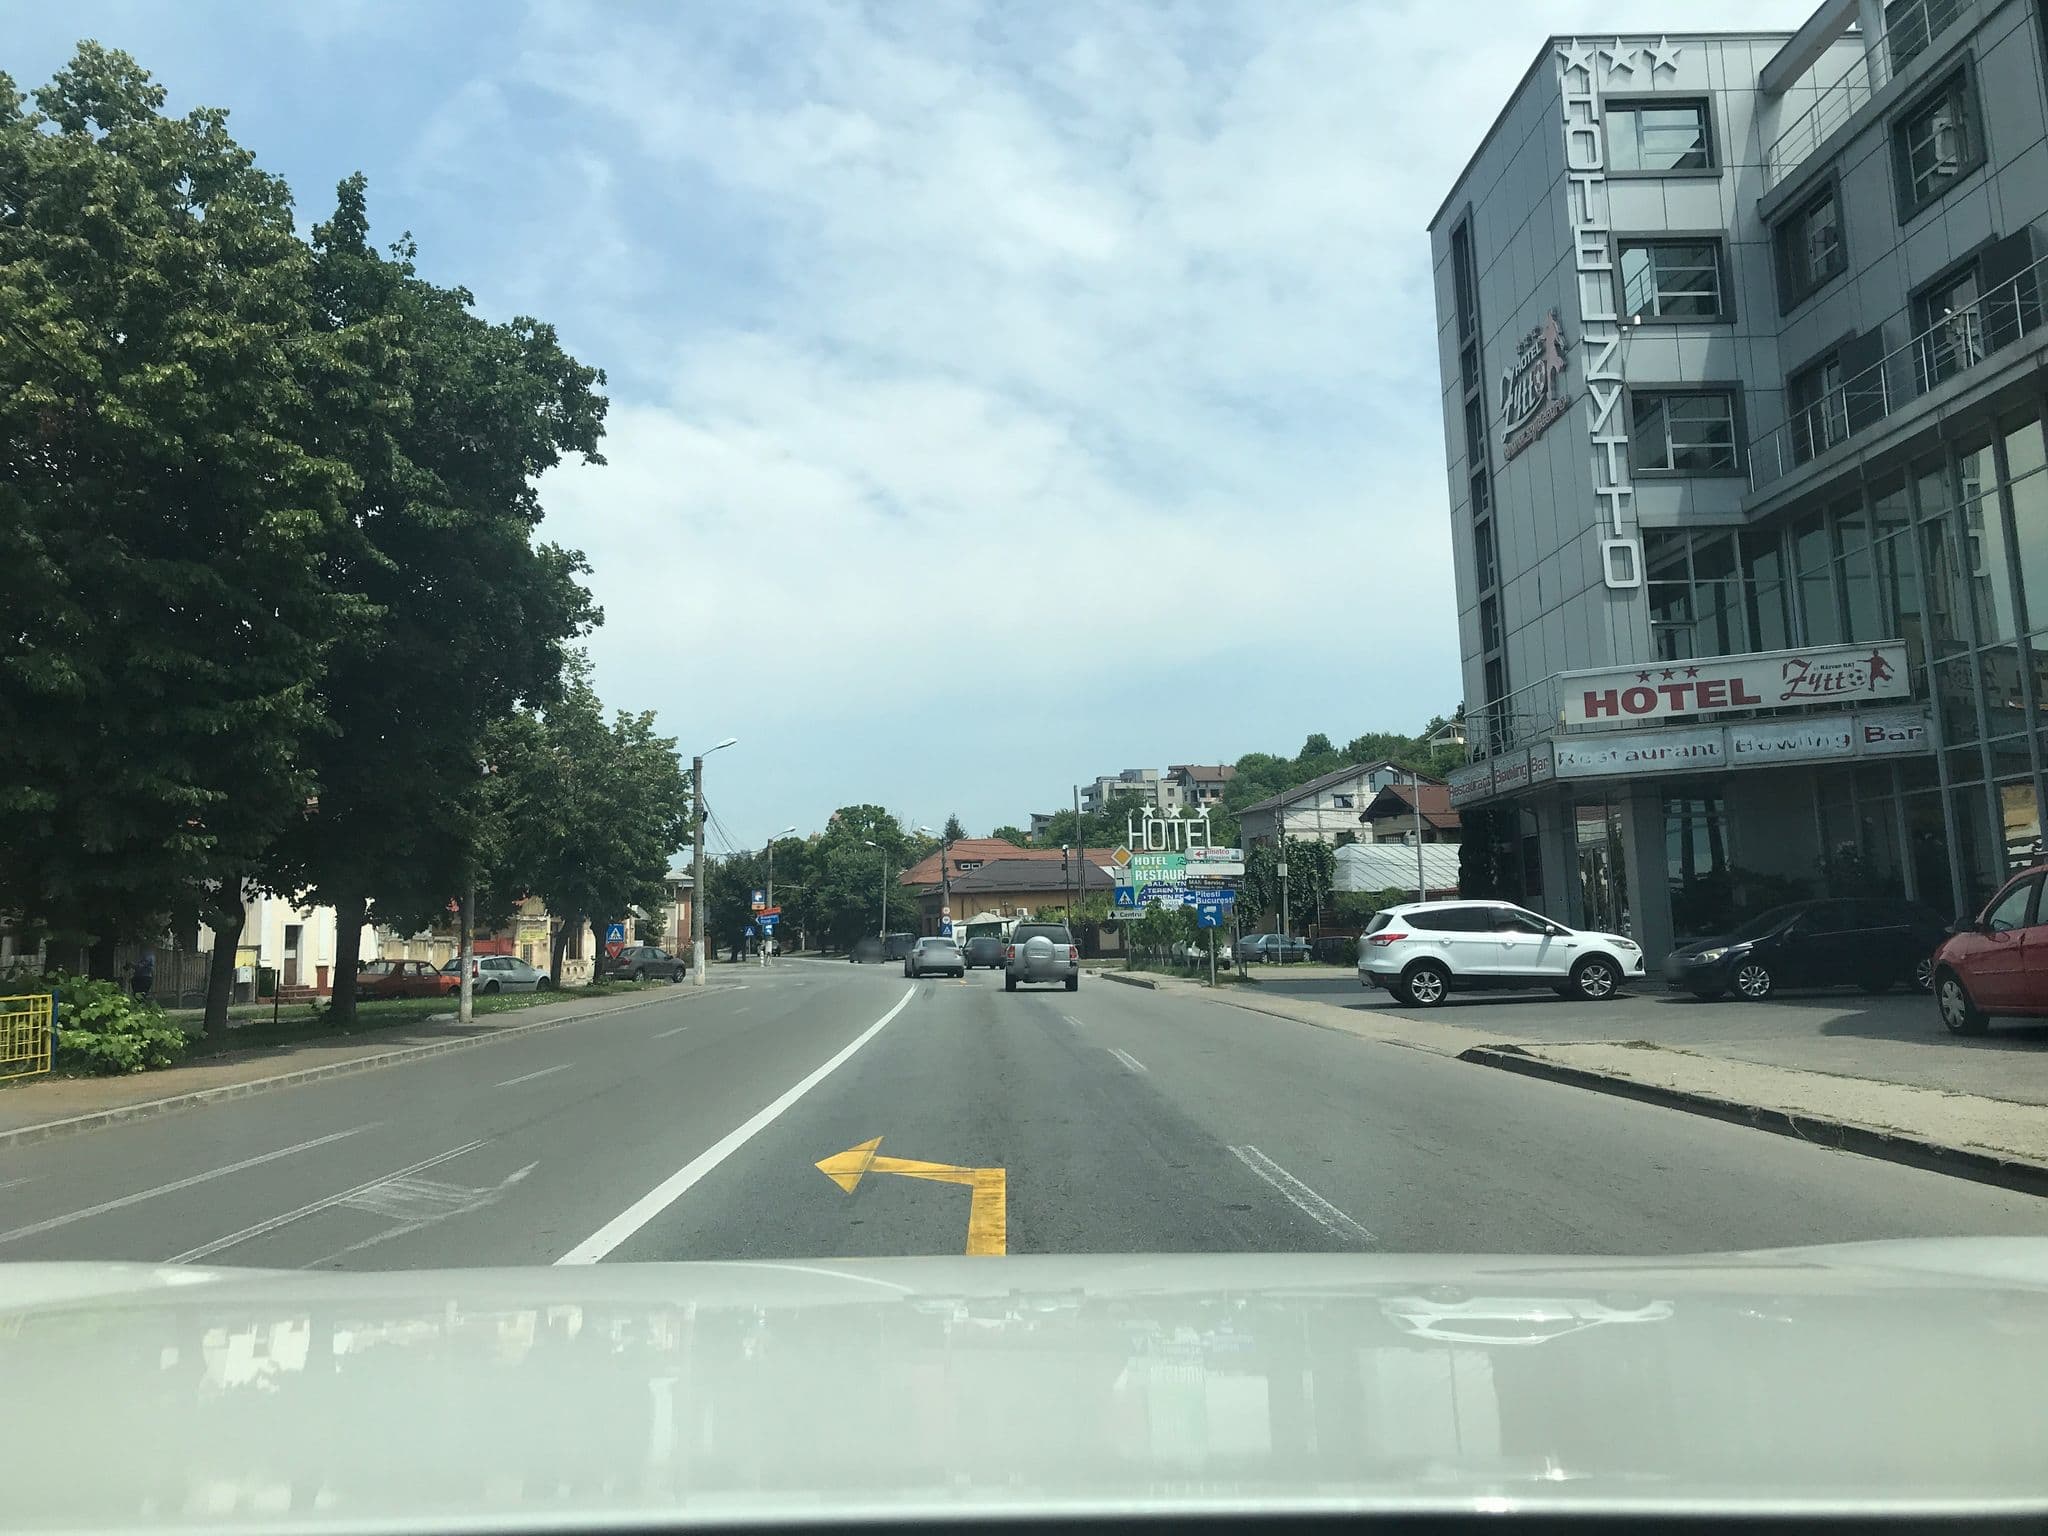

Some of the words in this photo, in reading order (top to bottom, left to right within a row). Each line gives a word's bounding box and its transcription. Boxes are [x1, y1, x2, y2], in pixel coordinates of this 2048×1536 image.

[1560, 76, 1619, 321] HOTEL
[1515, 342, 1543, 377] HOTEL
[1583, 334, 1641, 589] ZYTTO
[1584, 678, 1762, 718] HOTEL
[1557, 740, 1721, 767] Restaurant
[1735, 727, 1851, 755] Bowling
[1864, 724, 1924, 744] Bar
[1531, 756, 1548, 773] Bar
[1127, 817, 1225, 852] HOTEL
[1134, 856, 1168, 865] HOTEL
